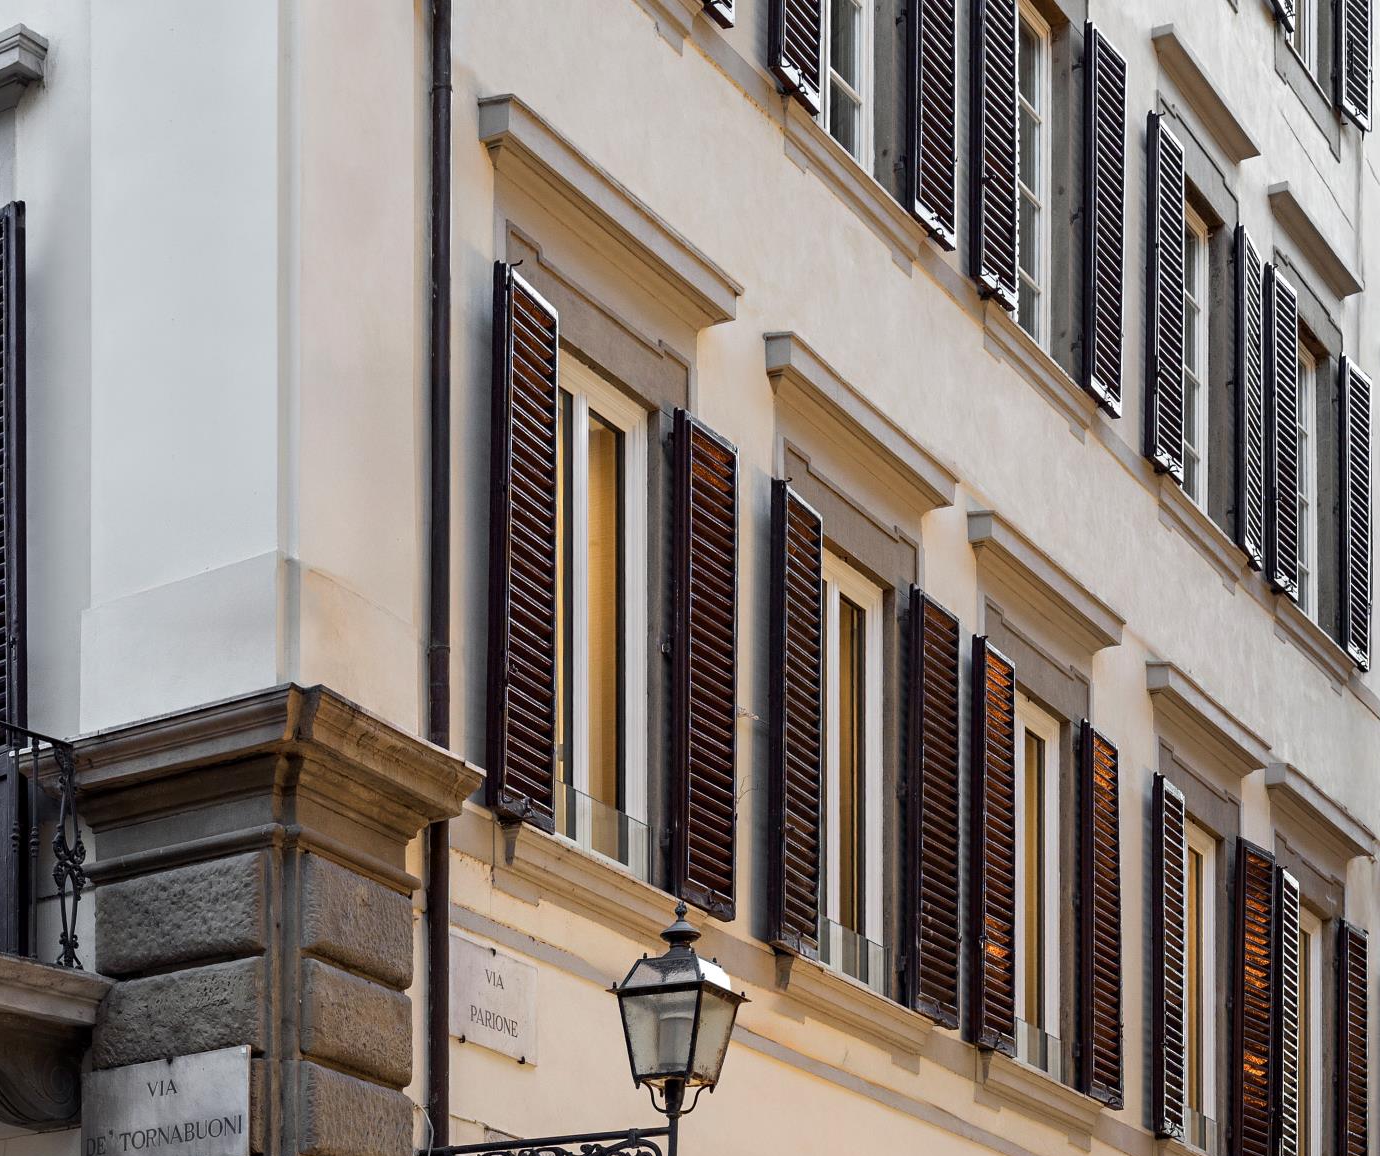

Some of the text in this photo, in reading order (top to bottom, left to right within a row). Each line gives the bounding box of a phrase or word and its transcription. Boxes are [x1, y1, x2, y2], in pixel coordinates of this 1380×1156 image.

[484, 968, 505, 990] VIA
[469, 1004, 519, 1038] PARIONE
[147, 1078, 178, 1097] VIA
[119, 1114, 243, 1152] TORNABUONI
